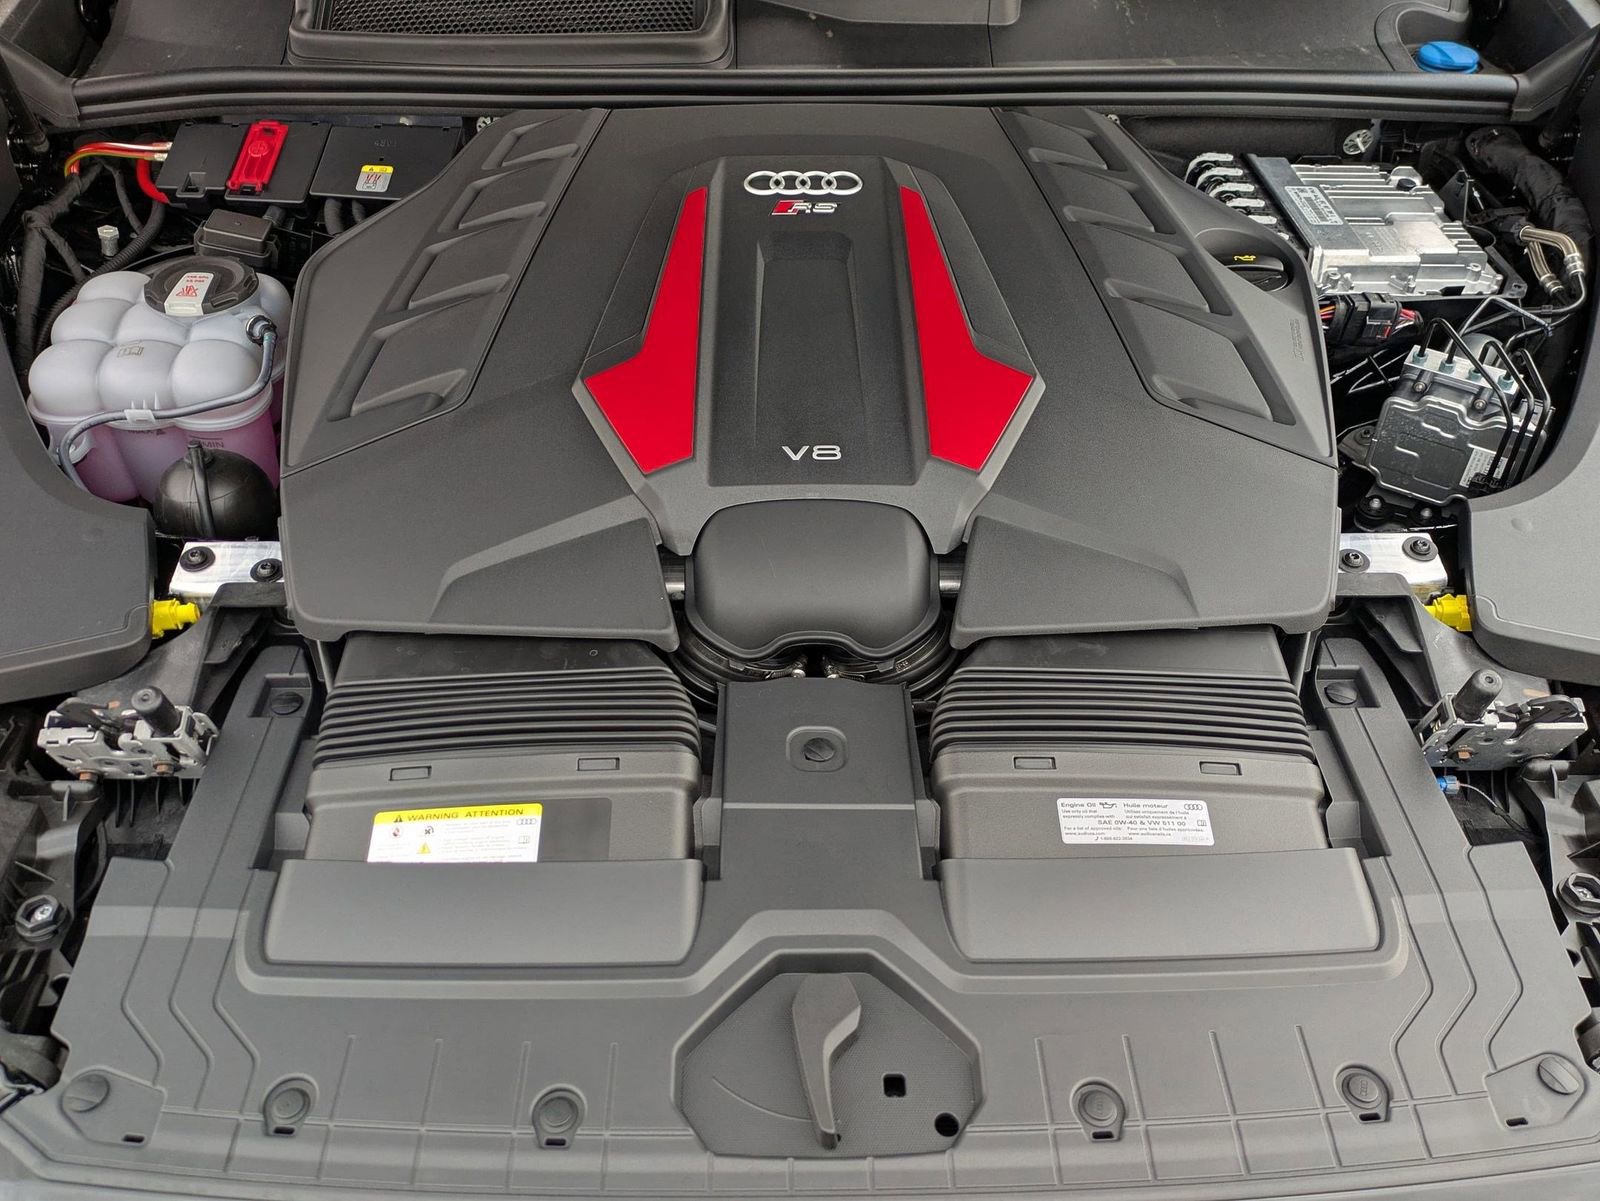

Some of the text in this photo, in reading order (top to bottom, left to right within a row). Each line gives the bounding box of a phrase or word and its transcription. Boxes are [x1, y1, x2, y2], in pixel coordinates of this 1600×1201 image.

[781, 445, 842, 461] V8
[407, 811, 459, 822] WARNING
[465, 808, 524, 818] ATTENTION
